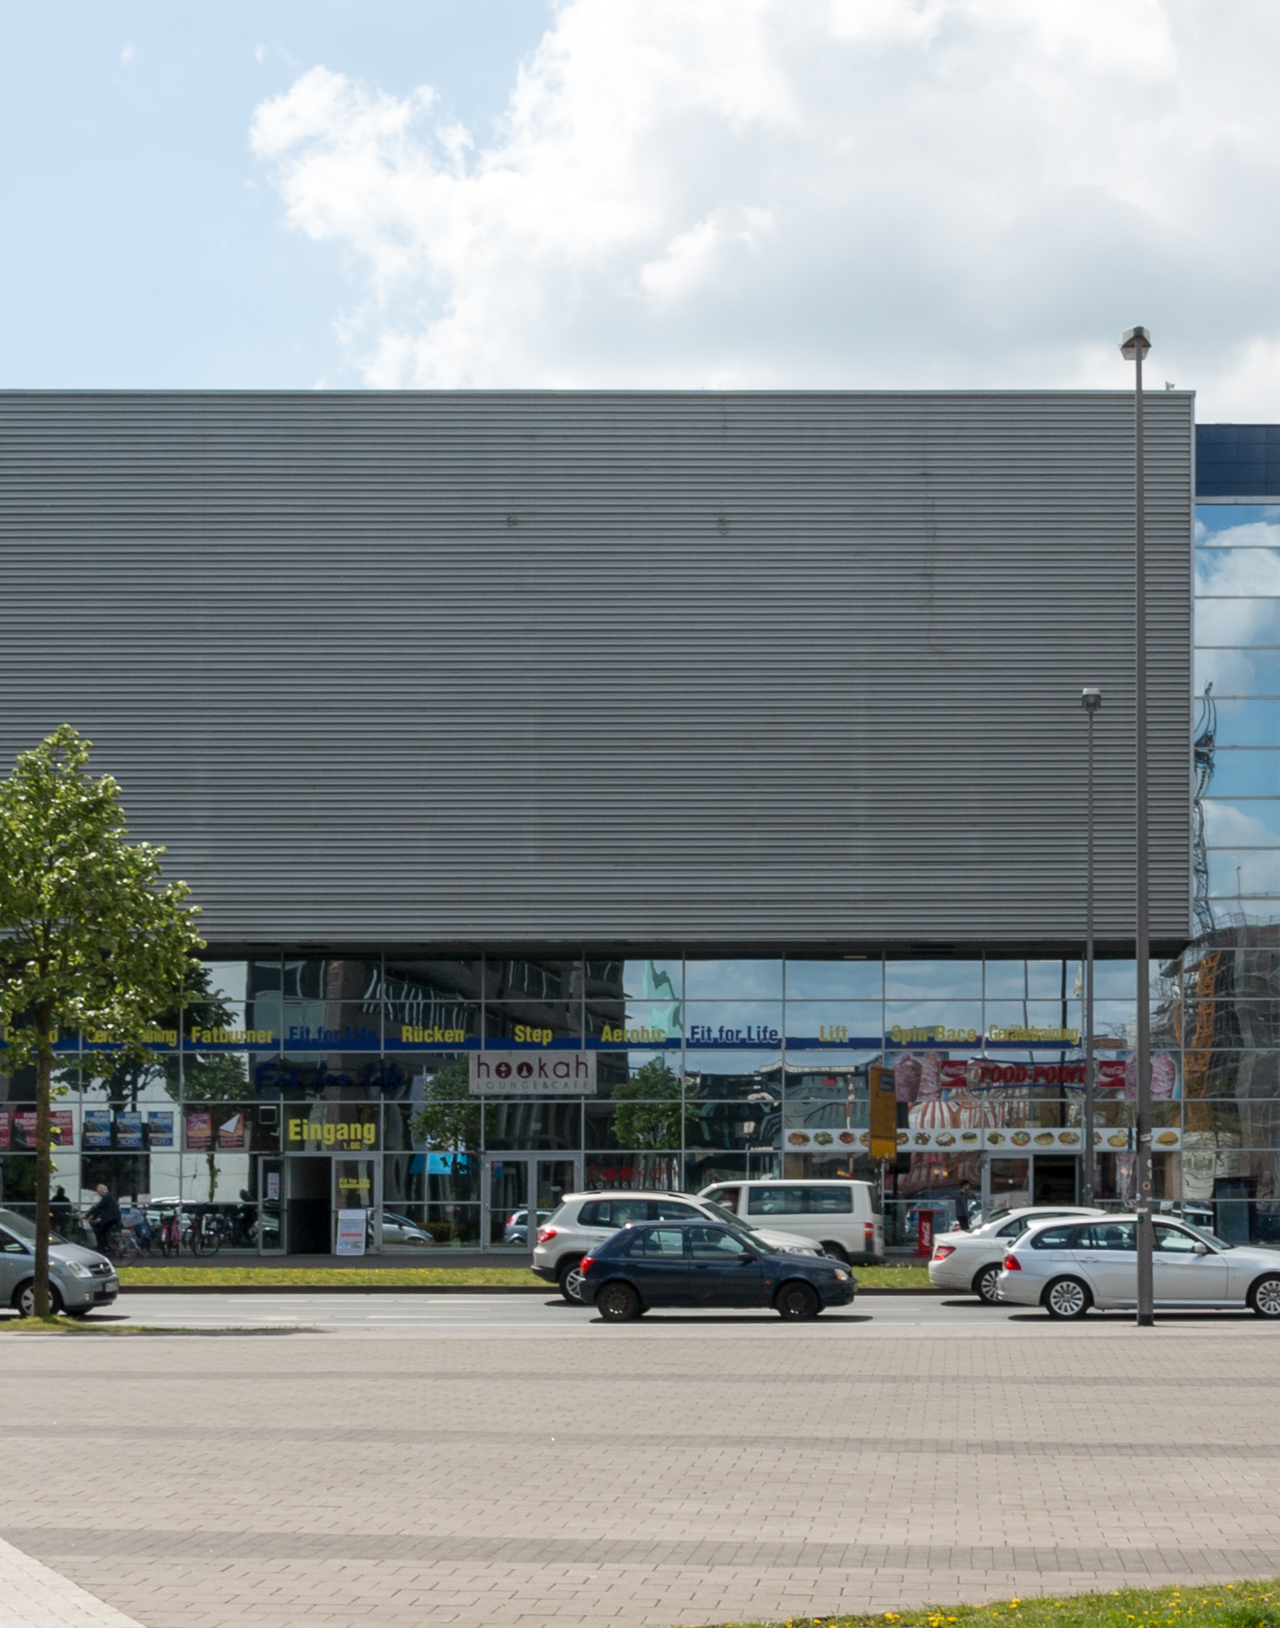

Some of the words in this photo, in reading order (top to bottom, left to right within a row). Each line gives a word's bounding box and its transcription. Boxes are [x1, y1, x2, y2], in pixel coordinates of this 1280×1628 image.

[190, 1026, 273, 1044] Fatburner
[401, 1025, 465, 1043] Rücken
[514, 1025, 553, 1046] Step
[601, 1025, 667, 1043] Aerobic
[689, 1025, 713, 1043] Fit
[717, 1025, 742, 1043] for
[746, 1025, 779, 1043] Life
[819, 1025, 849, 1043] Lift
[891, 1025, 977, 1045] Spin-Race
[477, 1054, 589, 1079] hookah
[288, 1118, 376, 1145] Eingang
